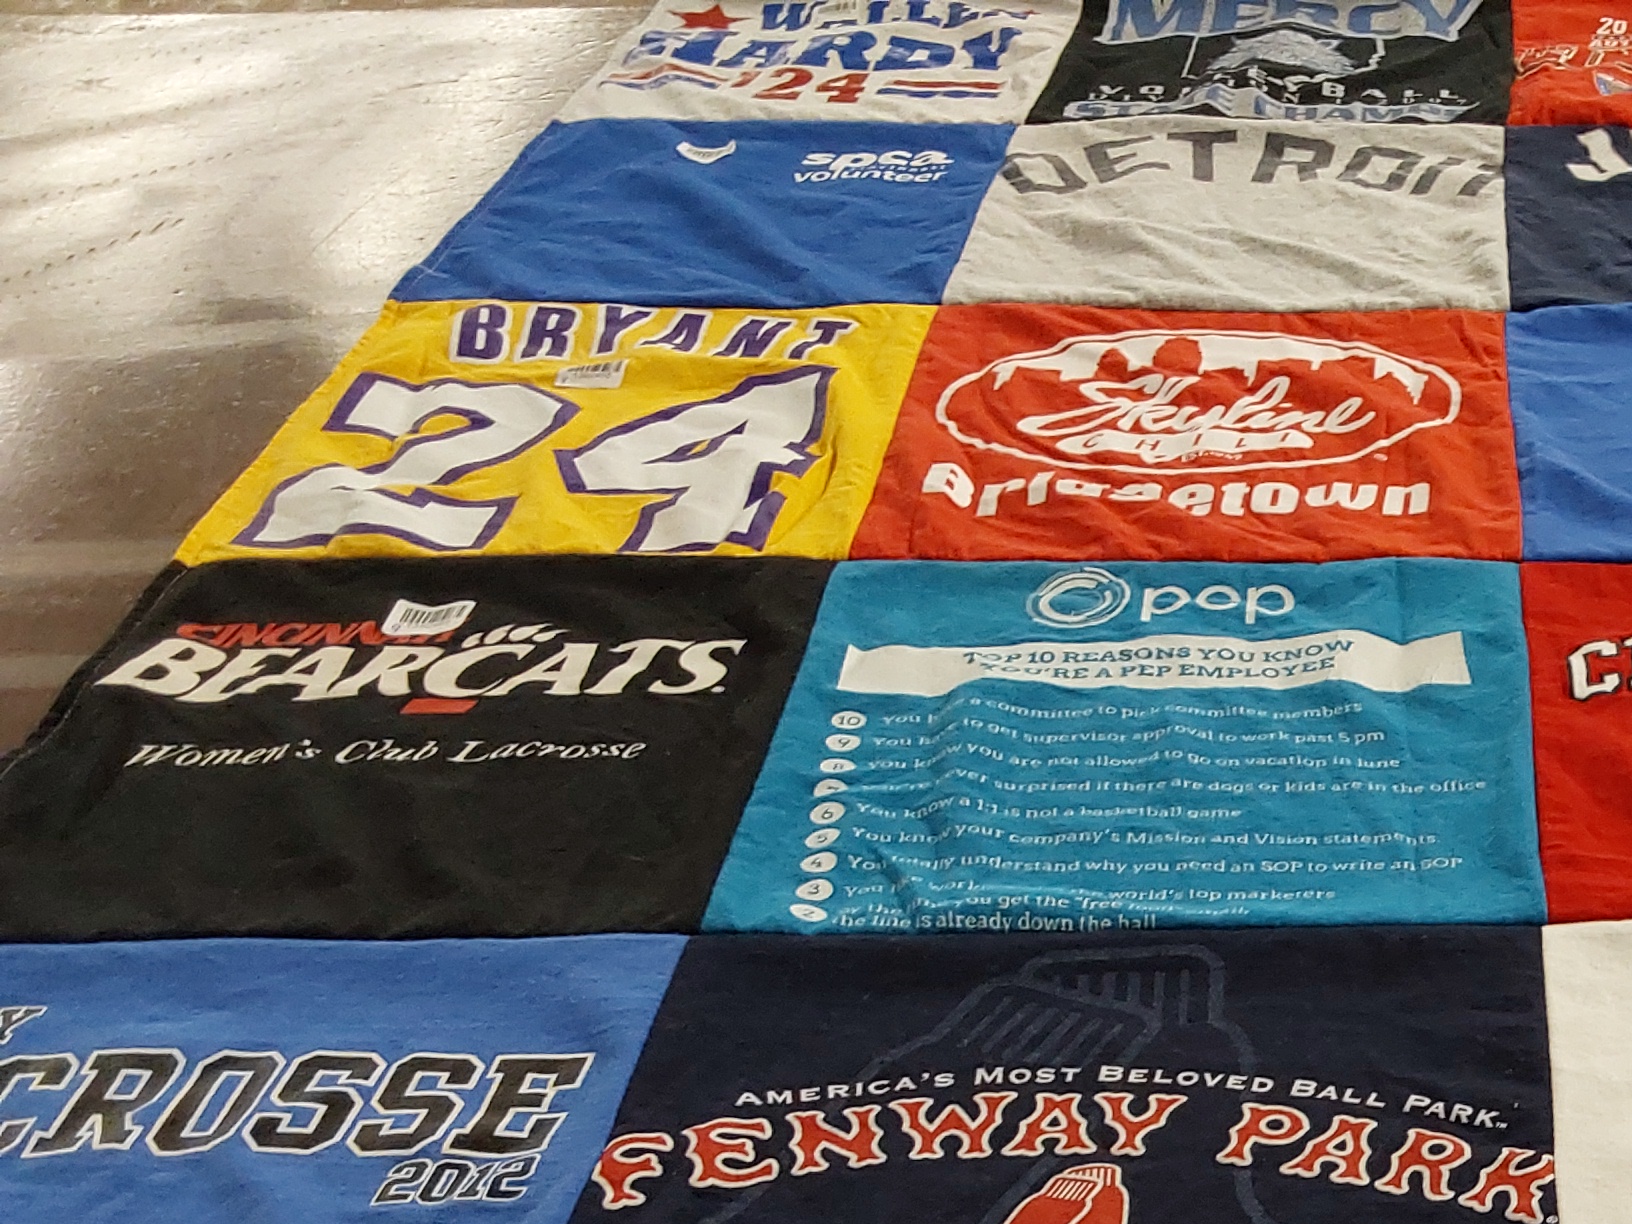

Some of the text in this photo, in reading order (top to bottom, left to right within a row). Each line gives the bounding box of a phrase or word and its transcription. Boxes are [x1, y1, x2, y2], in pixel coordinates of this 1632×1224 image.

[1092, 0, 1490, 42] MERCY
[1596, 17, 1628, 36] 20
[802, 150, 954, 180] spca
[1003, 130, 1502, 194] DETROIT
[794, 169, 949, 183] volunteer
[447, 302, 857, 365] BRYANT
[1016, 375, 1377, 442] Skyline
[1082, 432, 1292, 452] CHILI
[230, 364, 839, 554] 24
[175, 620, 455, 647] CINCINN
[963, 640, 1354, 664] TOP 10 REASONS YOU KNOW
[95, 637, 747, 703] BEARCATS
[980, 656, 1336, 679] YOU'RE A PEP EMPLOYEE
[882, 700, 1363, 724] You committee to committee members
[872, 717, 1385, 747] You to get supervisor approval to work past pm
[124, 737, 647, 768] Women's Club Lacrosse
[966, 743, 1352, 769] you are not allowed to go on vacation in
[994, 777, 1487, 794] surprised there are dogs or kids are in the office
[855, 802, 897, 819] You
[1025, 806, 1058, 819] not
[1079, 806, 1182, 819] basketball
[1187, 808, 1242, 820] game
[852, 827, 892, 843] You
[954, 823, 1005, 838] your
[1008, 828, 1121, 846] company's
[1126, 831, 1206, 845] Mission
[1210, 832, 1249, 845] and
[1254, 832, 1318, 846] Vision
[848, 854, 887, 871] You
[960, 855, 1081, 873] understand
[1085, 859, 1128, 874] why
[1132, 862, 1170, 874] you
[1175, 860, 1226, 873] need
[1230, 863, 1255, 873] an
[1260, 861, 1304, 873] SOP
[1307, 861, 1328, 873] to
[1332, 860, 1386, 873] write
[1390, 860, 1416, 873] an
[1420, 857, 1464, 873] SOP
[998, 895, 1071, 909] get the
[1107, 887, 1183, 901] world's
[1188, 888, 1222, 902] top
[1227, 889, 1337, 902] marketers
[936, 911, 1157, 933] already down the hall
[735, 1072, 956, 1107] AMERICA'S
[974, 1065, 1082, 1087] MOST
[1097, 1065, 1275, 1093] BELOVED
[1290, 1079, 1387, 1108] BALL
[592, 1091, 1189, 1210] FENWAY
[370, 1154, 541, 1206] 2012
